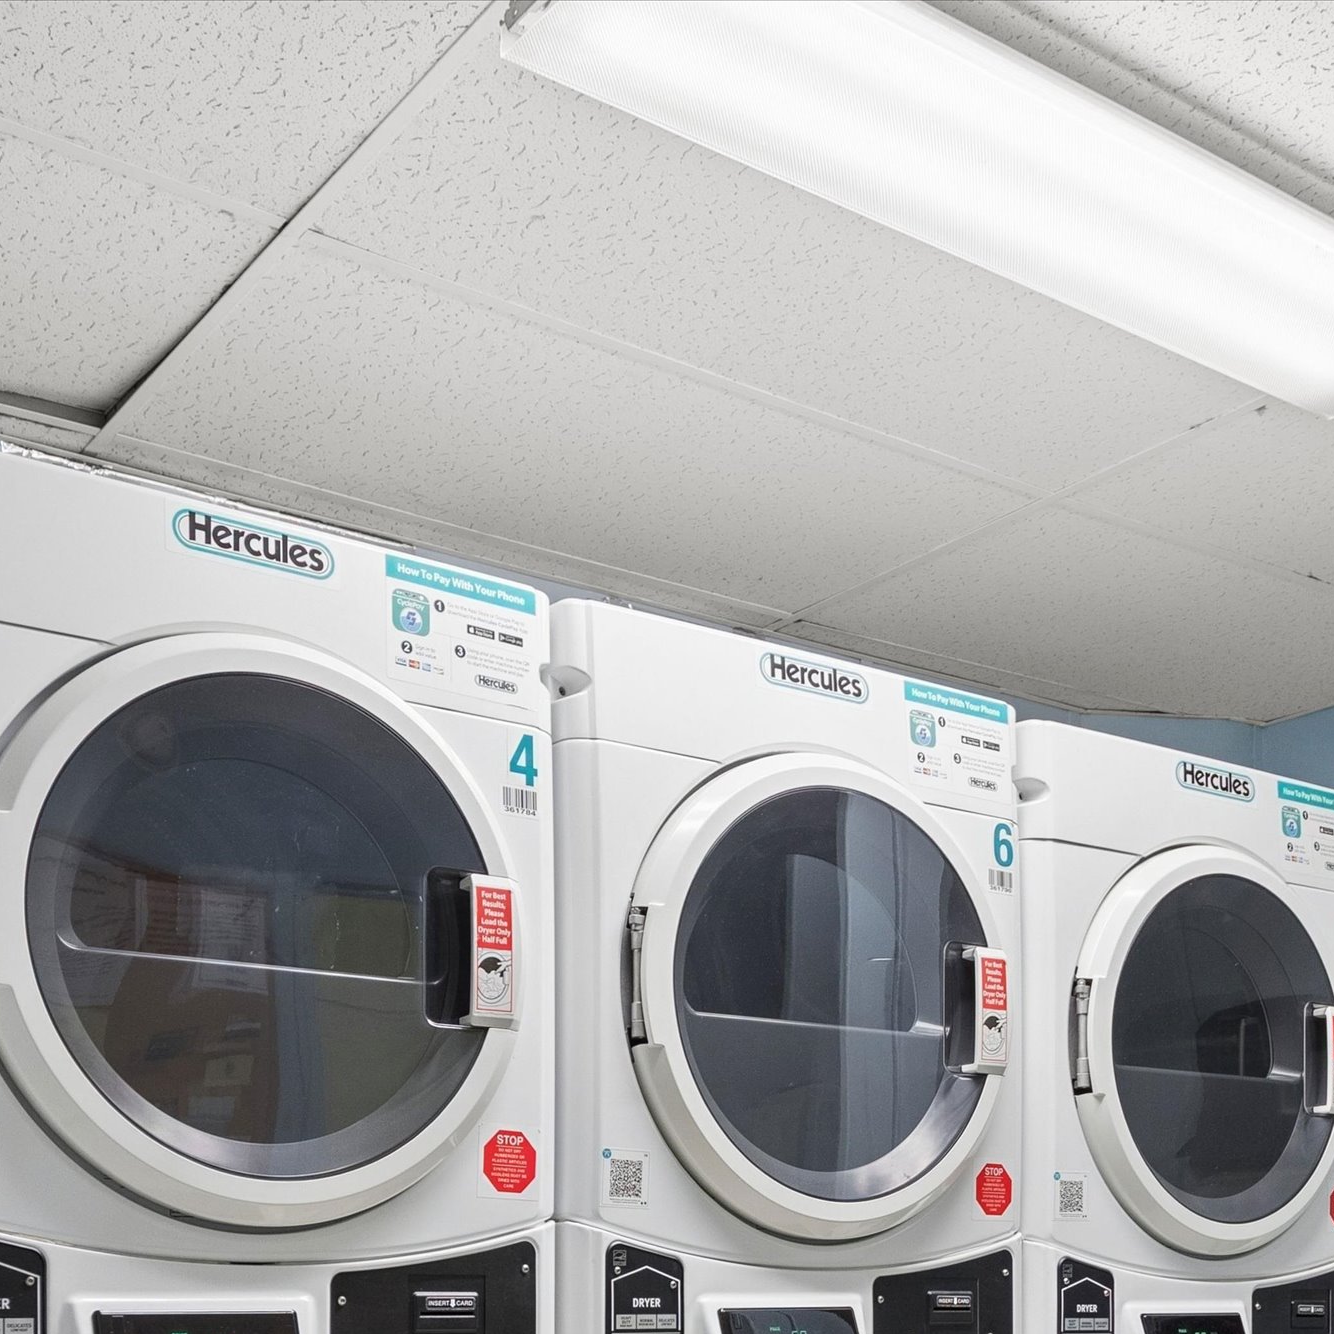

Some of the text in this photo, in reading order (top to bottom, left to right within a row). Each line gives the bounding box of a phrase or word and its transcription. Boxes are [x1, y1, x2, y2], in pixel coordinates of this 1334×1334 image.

[188, 510, 325, 572] Hercules
[478, 675, 516, 693] Hercules
[769, 653, 862, 698] Hercules
[509, 734, 538, 787] 4
[1183, 762, 1250, 797] Hercules
[504, 806, 536, 817] 361784
[993, 823, 1014, 867] 6
[496, 1134, 524, 1146] STOP
[984, 1167, 1003, 1176] STOP
[632, 1298, 661, 1308] DRYER
[1076, 1304, 1098, 1313] DRYER
